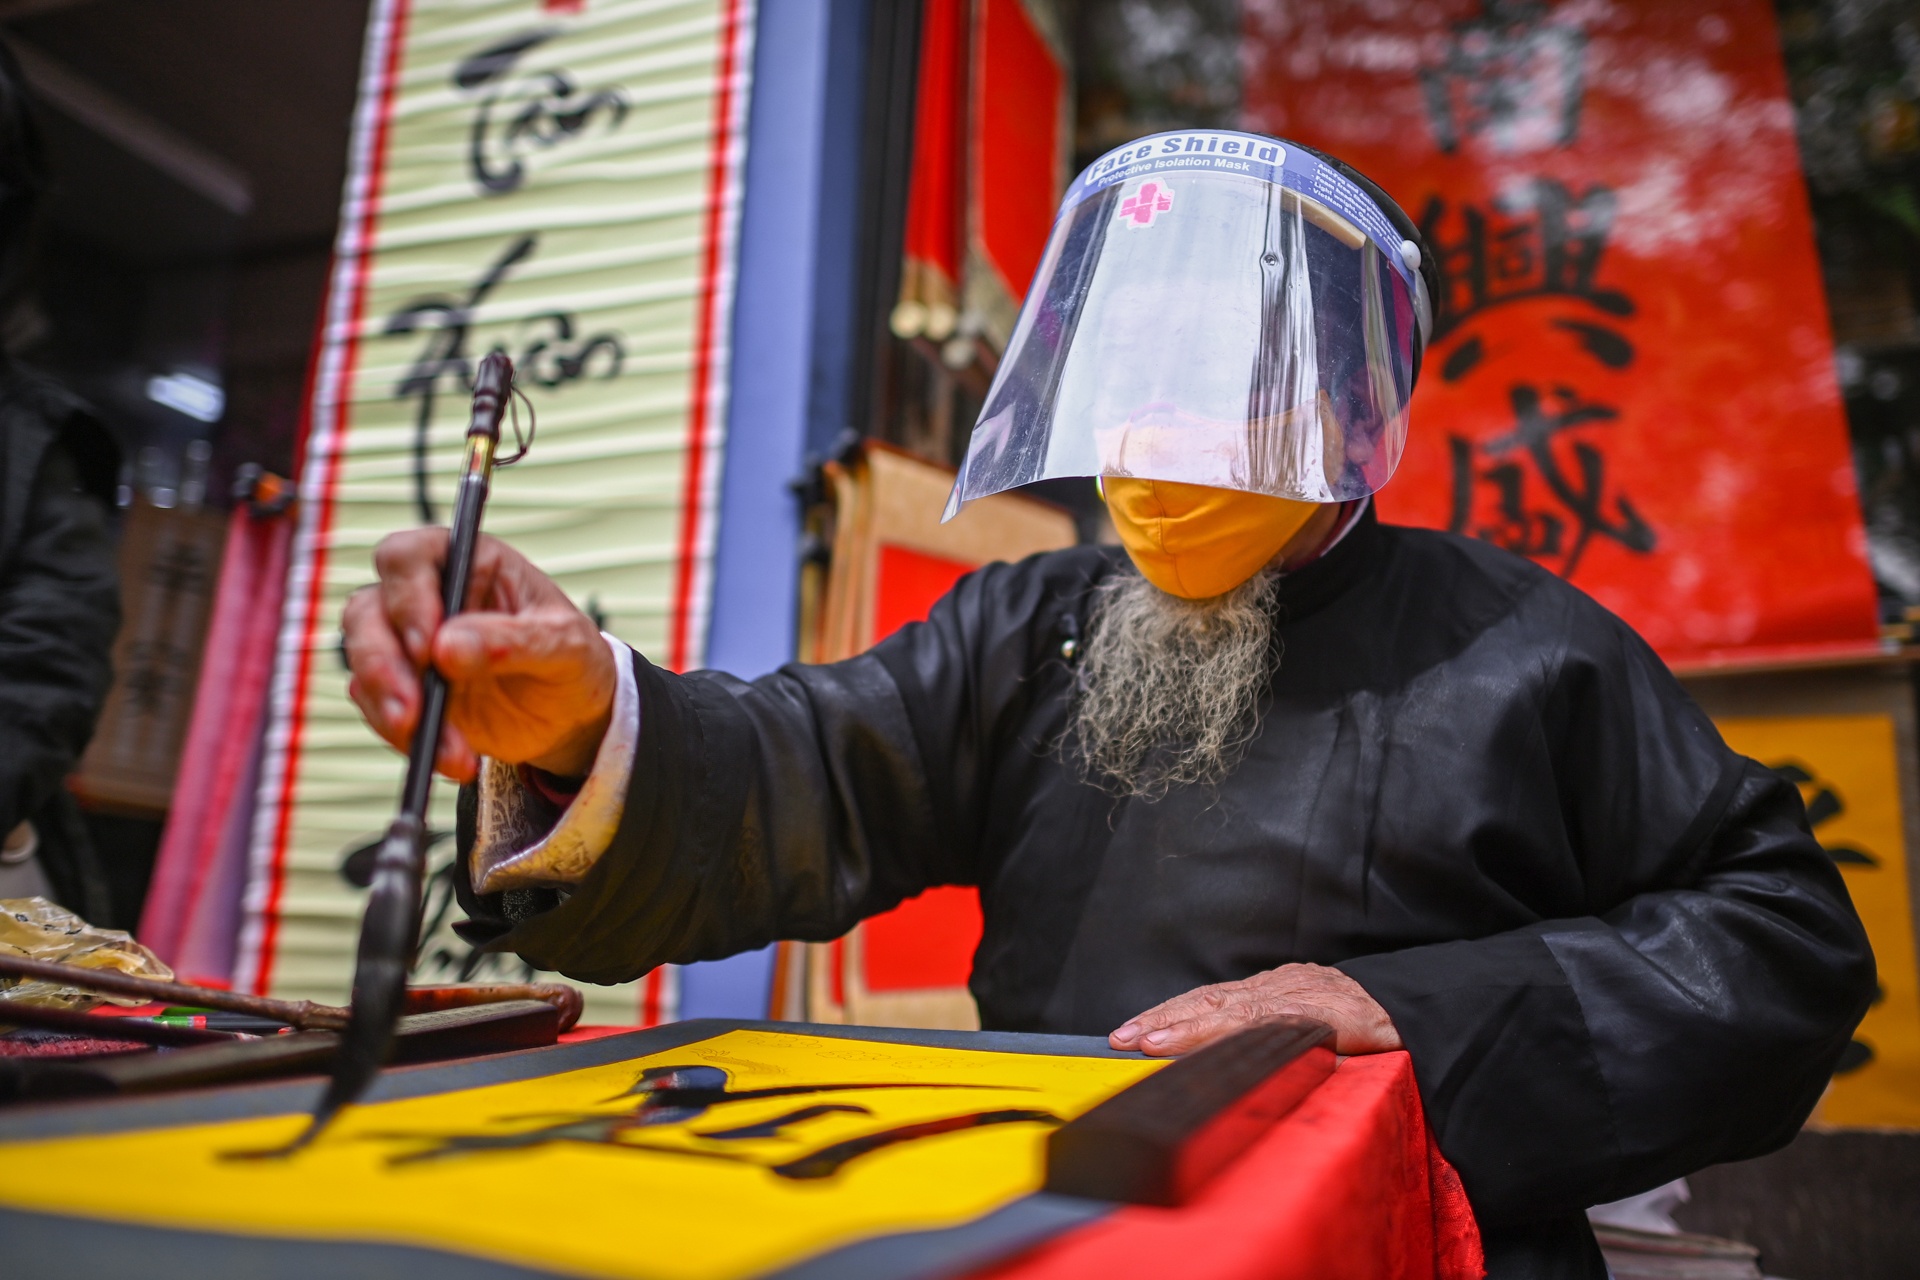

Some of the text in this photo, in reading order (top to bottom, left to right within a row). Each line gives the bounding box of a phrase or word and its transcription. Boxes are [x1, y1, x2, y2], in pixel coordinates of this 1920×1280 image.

[1091, 137, 1278, 181] Face Shield
[1098, 157, 1250, 187] Protective Isolation Mask
[1317, 169, 1336, 184] Latex
[1318, 163, 1346, 185] Anti-Fog
[1314, 182, 1333, 196] Light
[1315, 176, 1334, 191] Foam
[1313, 187, 1343, 210] VietNam
[1343, 208, 1372, 232] Standard
